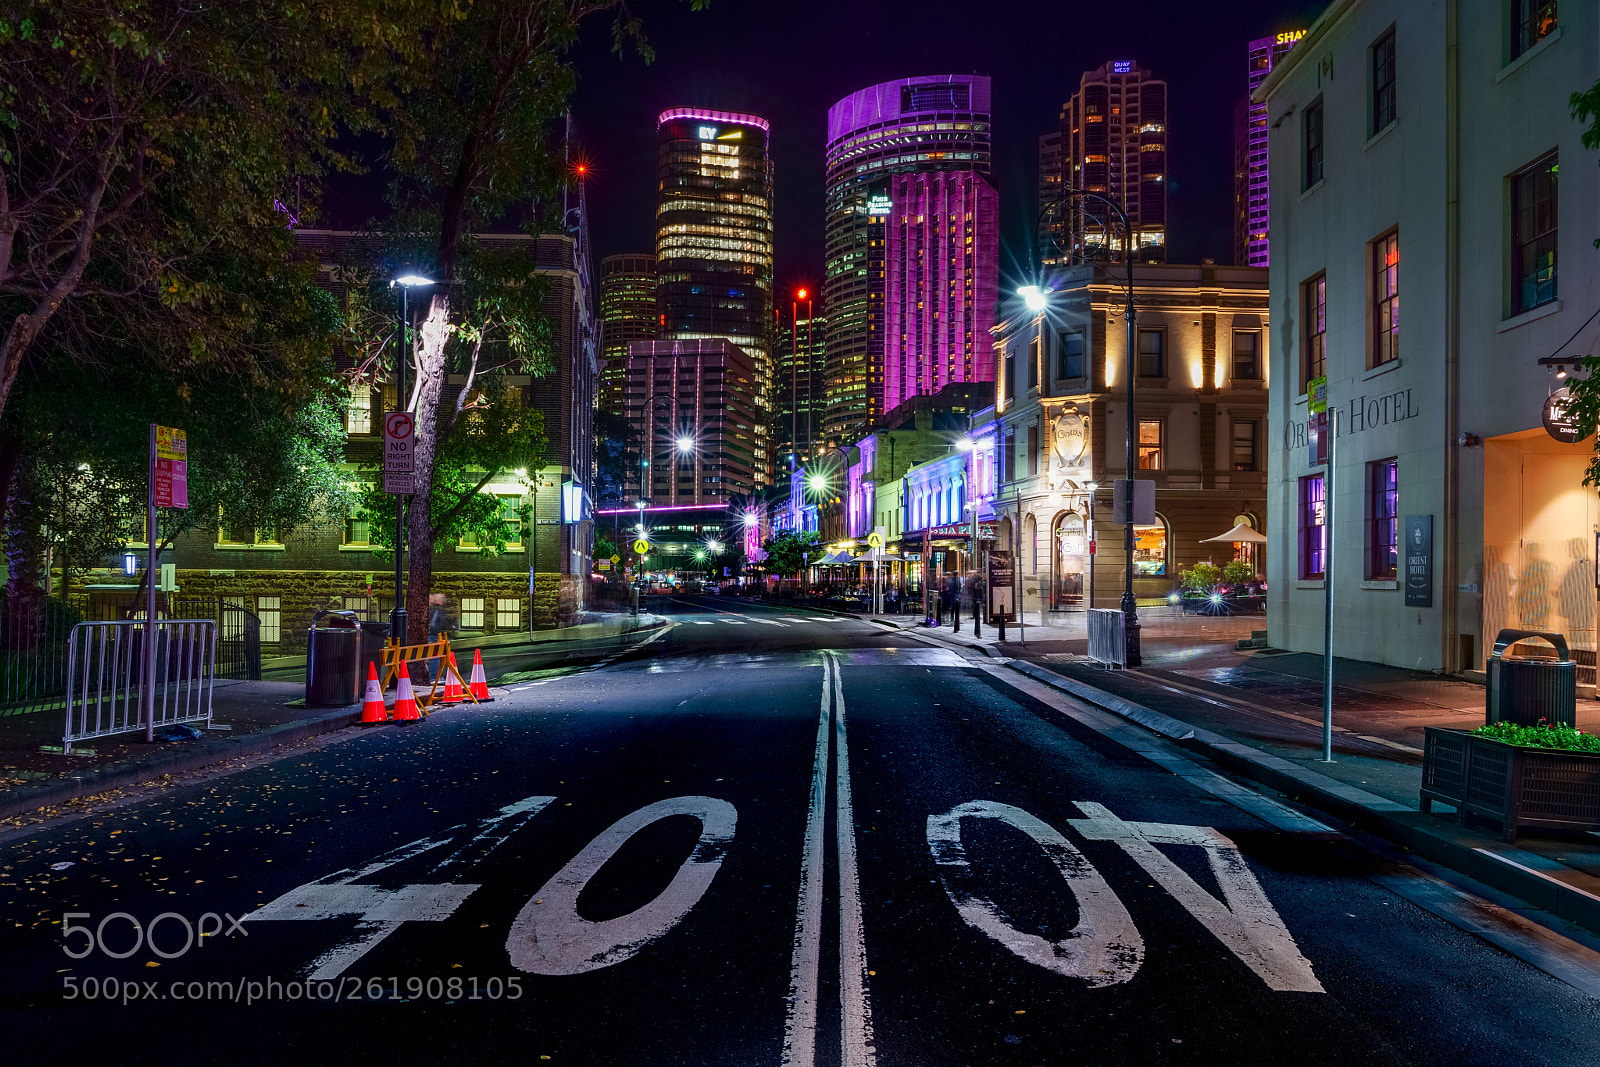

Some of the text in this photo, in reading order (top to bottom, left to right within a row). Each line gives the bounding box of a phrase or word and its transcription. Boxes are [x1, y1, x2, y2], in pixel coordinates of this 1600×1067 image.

[699, 126, 717, 140] EY
[1284, 388, 1419, 452] ORIT HOTEL
[390, 442, 407, 451] NO
[1408, 555, 1427, 565] ORIENT
[1409, 565, 1426, 574] HOTEL
[239, 795, 738, 981] 40
